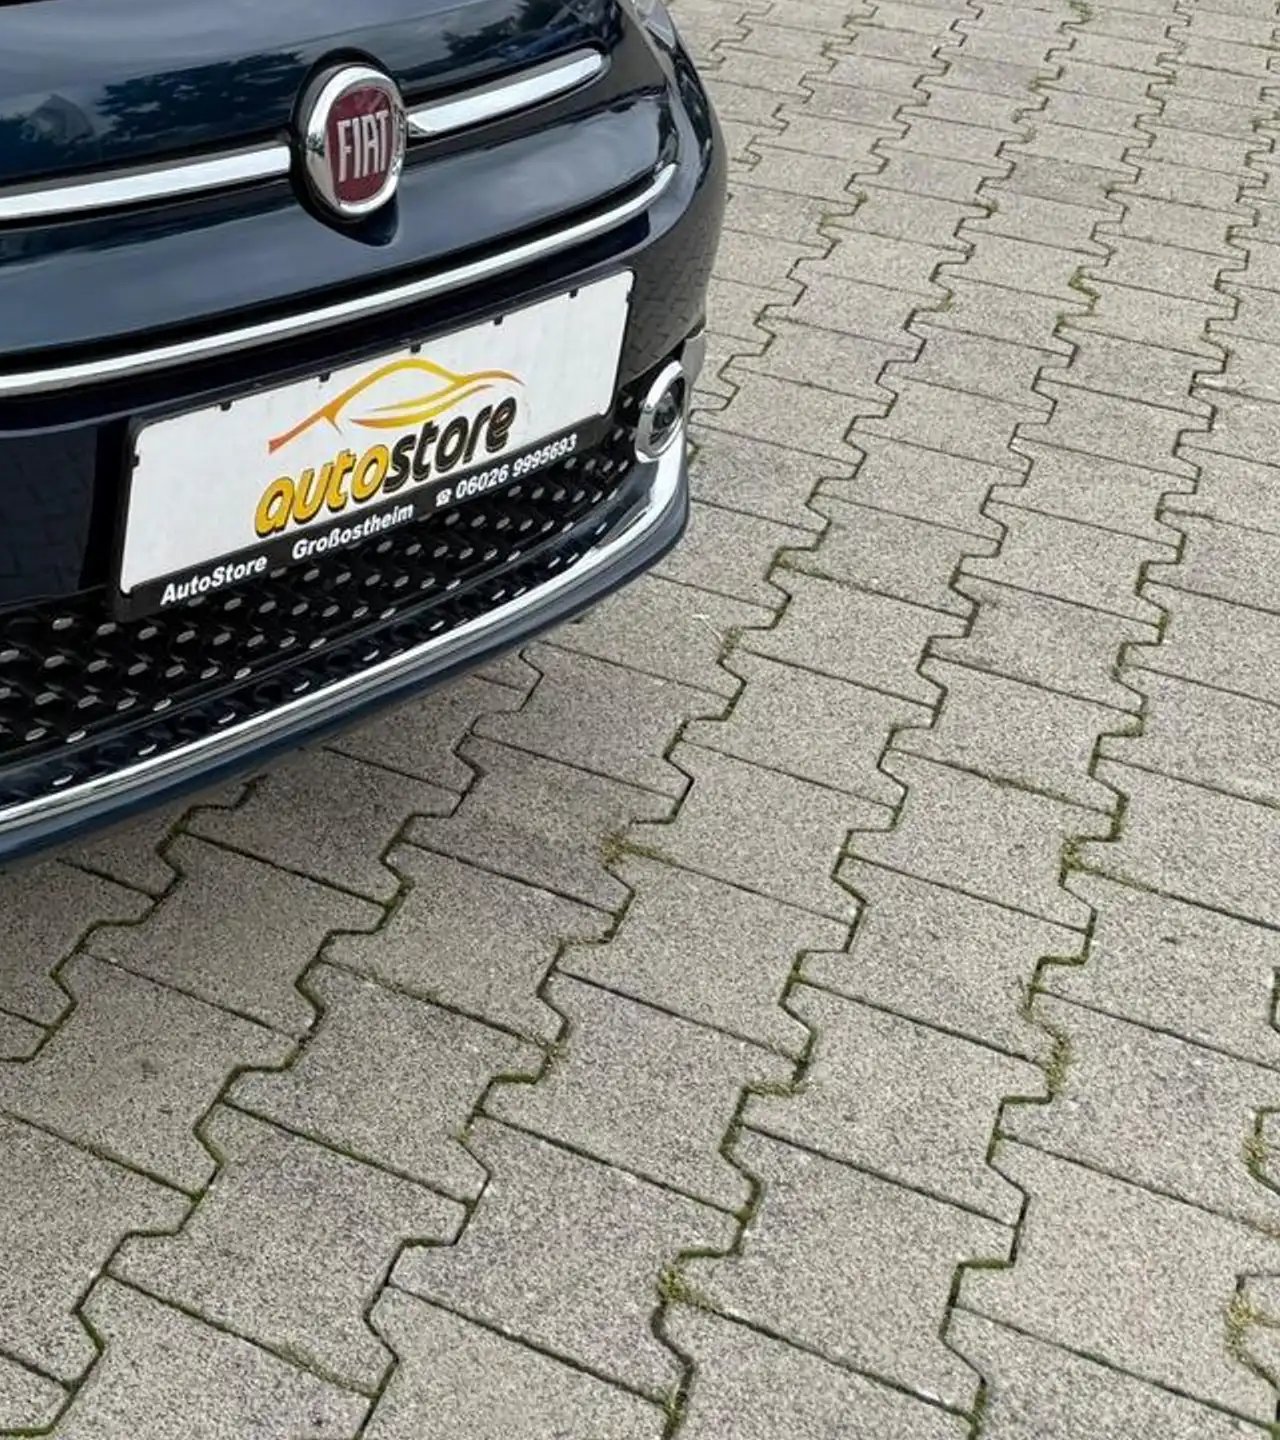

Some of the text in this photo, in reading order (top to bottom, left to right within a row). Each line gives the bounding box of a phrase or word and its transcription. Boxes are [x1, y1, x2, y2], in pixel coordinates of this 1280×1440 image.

[337, 110, 390, 183] FIAT
[160, 434, 578, 606] AutoStore Großostheim 06026 9995693
[254, 396, 517, 539] autostore
